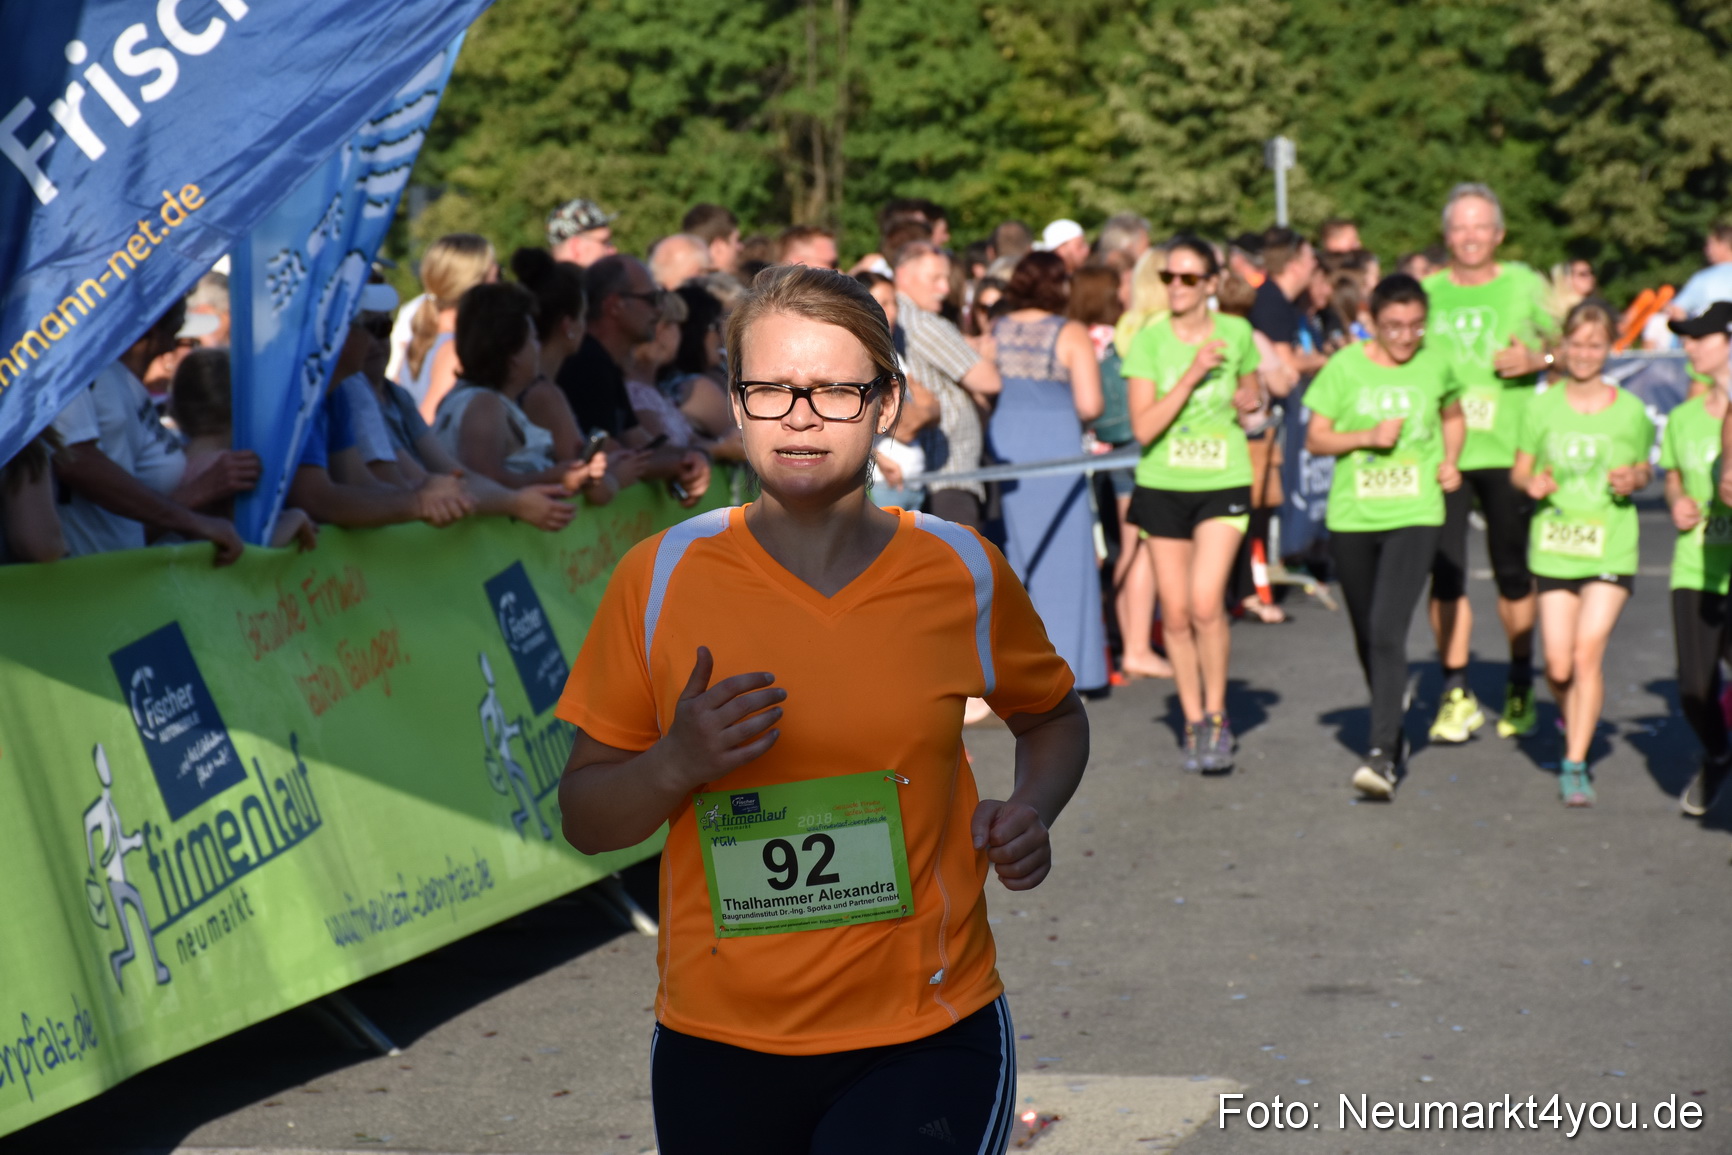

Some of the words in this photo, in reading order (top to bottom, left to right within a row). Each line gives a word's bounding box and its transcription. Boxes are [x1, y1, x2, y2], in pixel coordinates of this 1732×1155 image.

[0, 0, 249, 206] Frisc
[0, 183, 206, 392] hmann-net.de
[1174, 438, 1221, 459] 2052
[1361, 466, 1413, 488] 2055
[1546, 521, 1597, 545] 2054
[142, 683, 195, 729] Fischer
[143, 731, 323, 921] firmenlauf
[721, 806, 787, 826] firmenlauf
[797, 812, 832, 828] 2018
[762, 833, 840, 891] 92
[722, 910, 778, 921] Baugrundinstitut
[779, 907, 805, 916] Dr.-Ing.
[807, 903, 832, 914] Spotka
[833, 900, 848, 909] und
[849, 897, 875, 907] Partner
[876, 893, 900, 903] GmbH
[723, 891, 814, 912] Thalhammer
[818, 880, 895, 902] Alexandra
[176, 885, 254, 965] neumarkt
